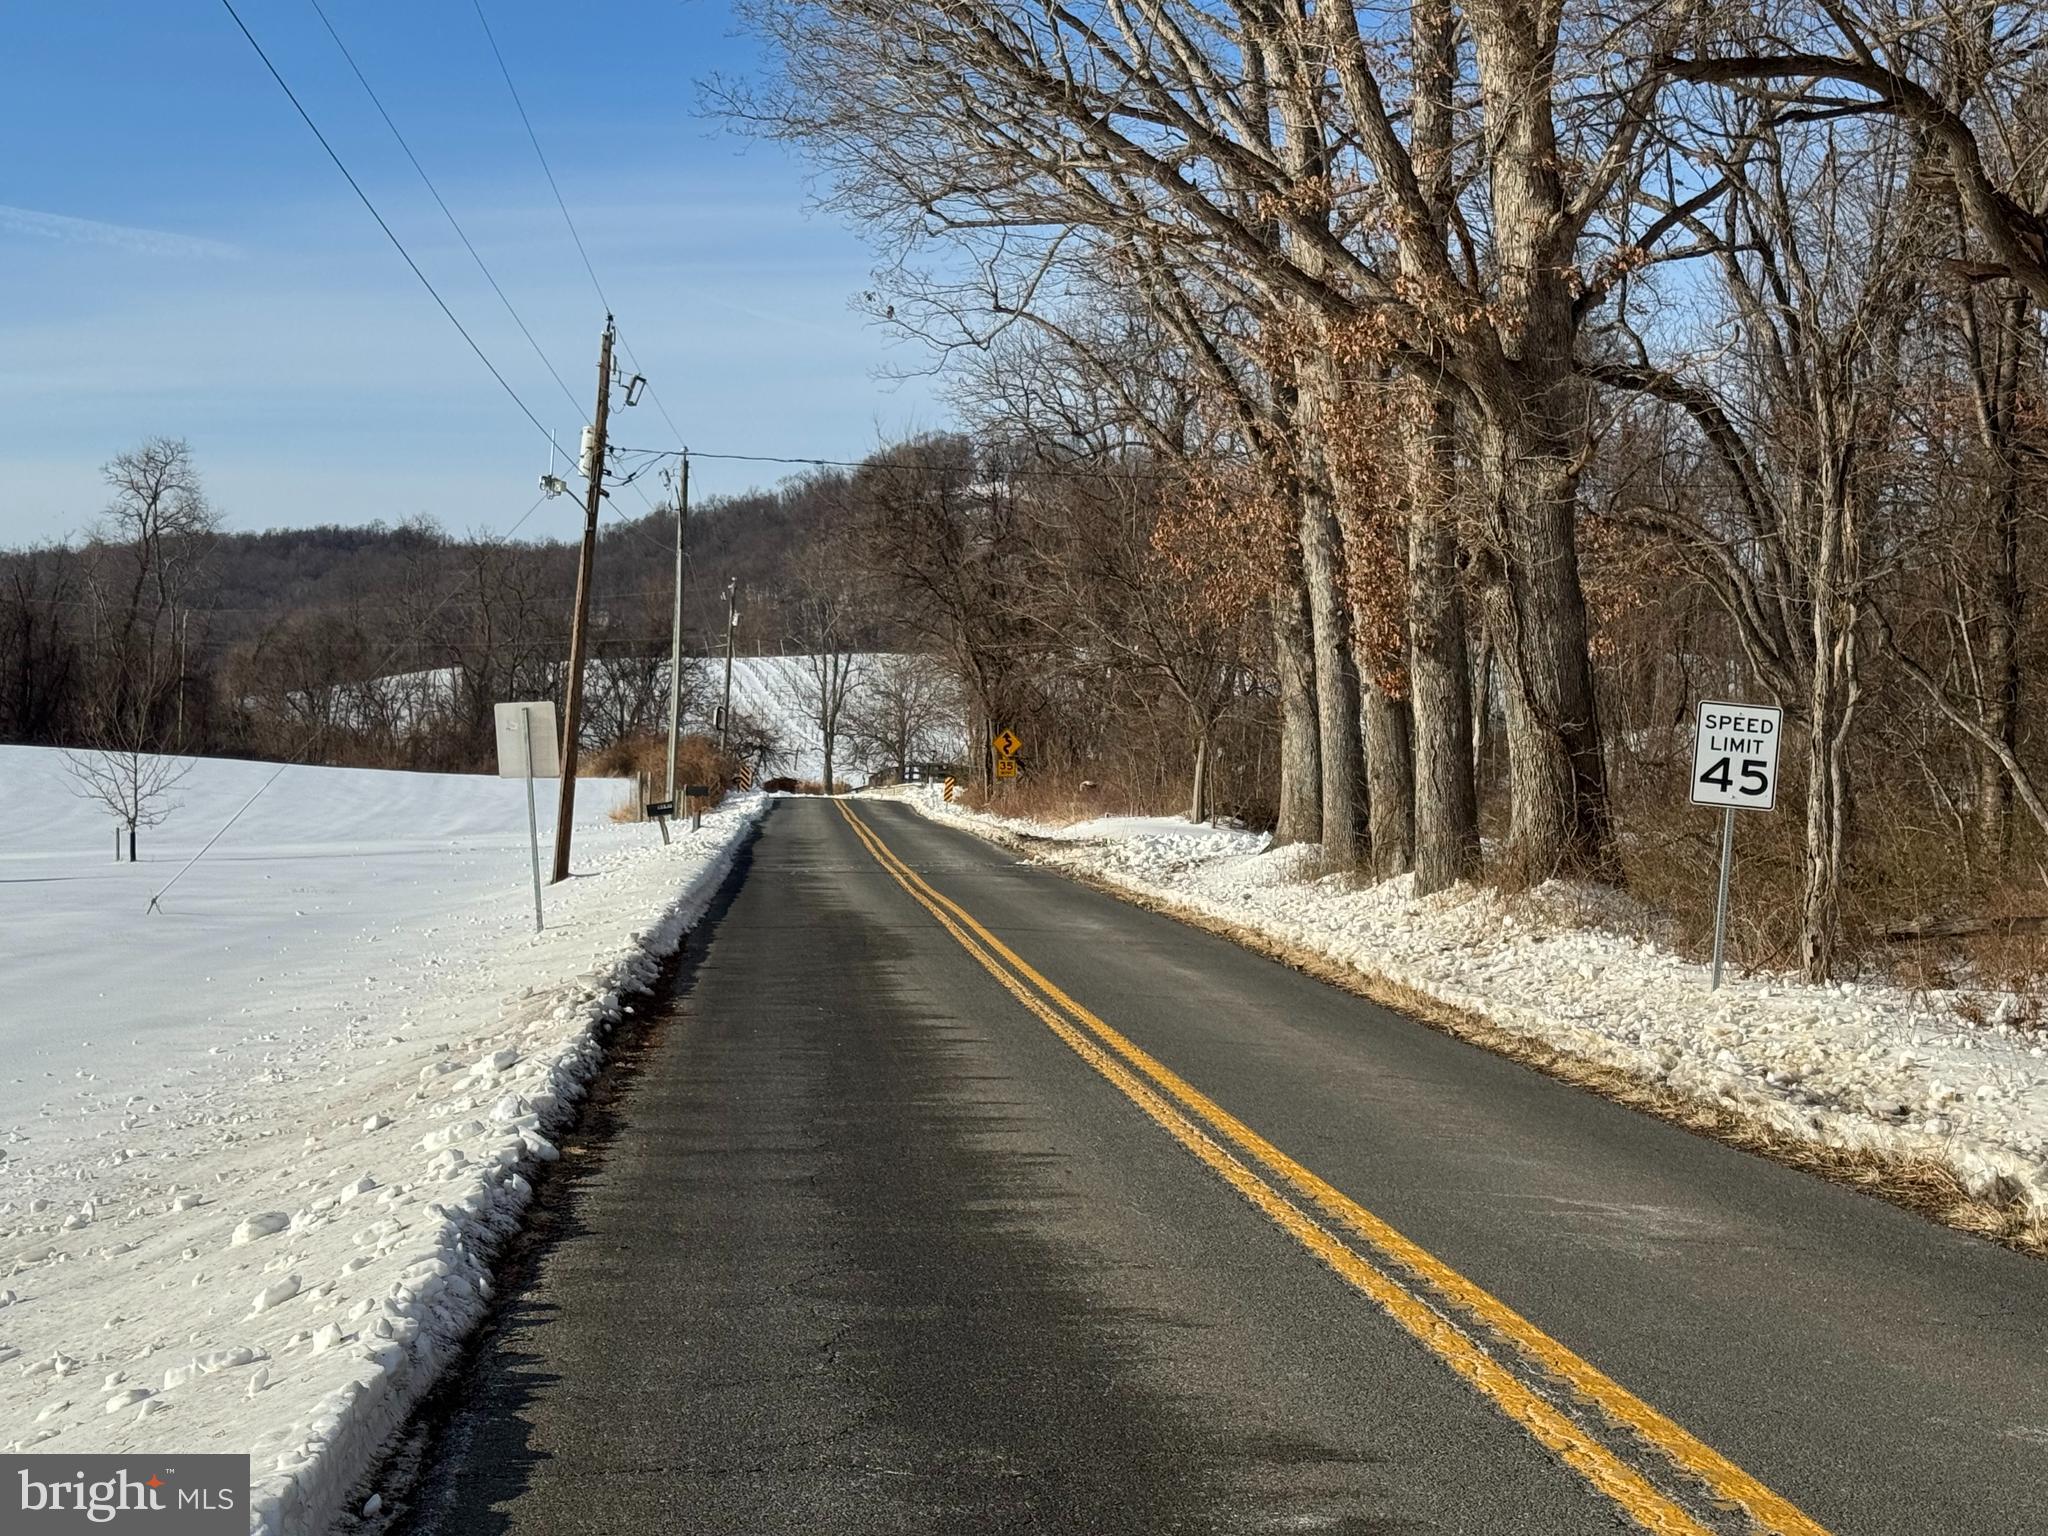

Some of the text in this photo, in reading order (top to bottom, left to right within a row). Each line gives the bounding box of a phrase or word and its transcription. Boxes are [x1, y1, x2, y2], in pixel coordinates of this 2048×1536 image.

[1705, 714, 1773, 734] SPEED
[1710, 736, 1764, 755] LIMIT
[1000, 761, 1014, 771] 35
[1699, 757, 1768, 796] 45
